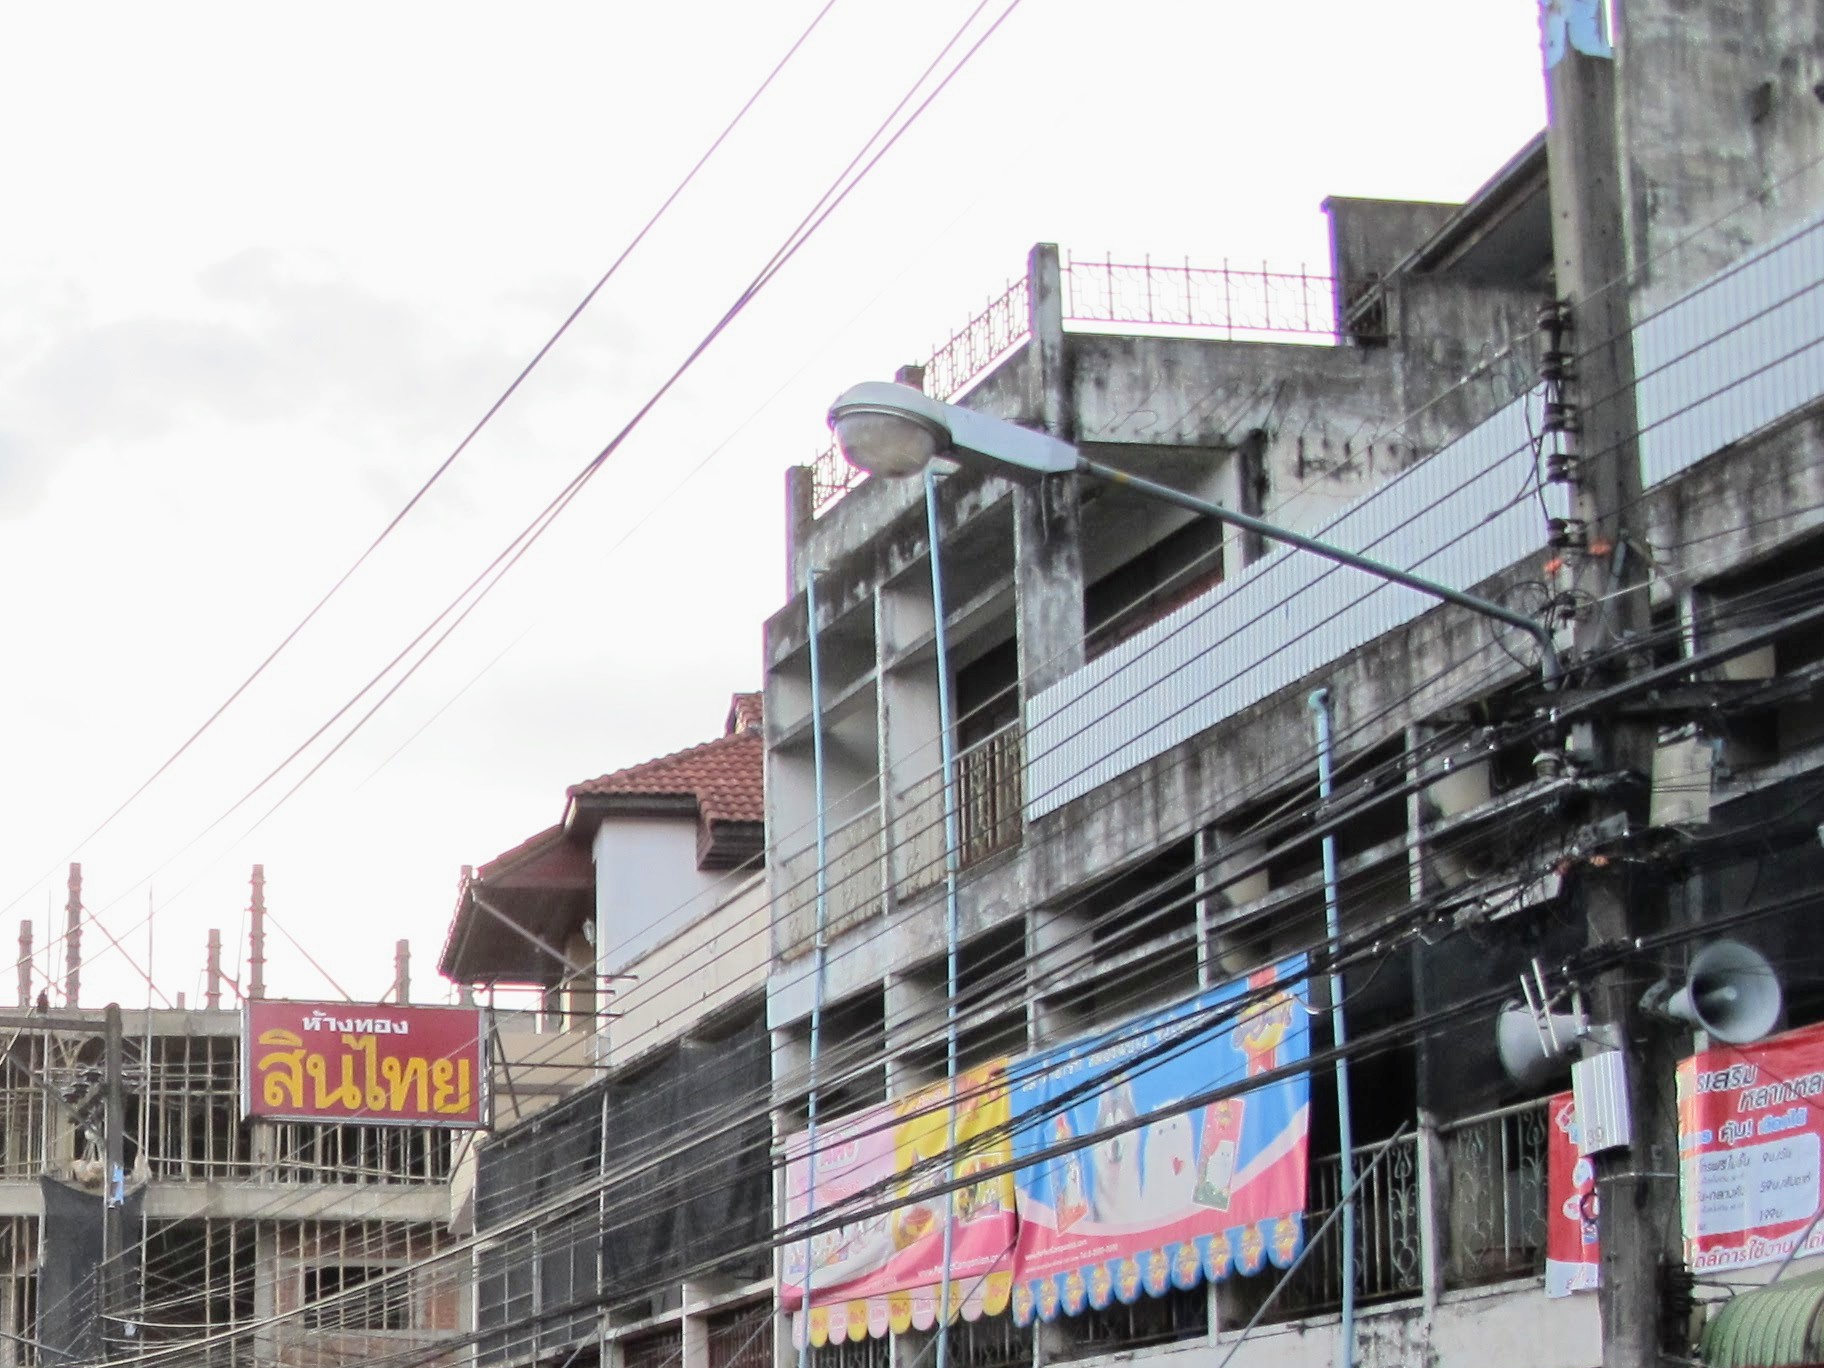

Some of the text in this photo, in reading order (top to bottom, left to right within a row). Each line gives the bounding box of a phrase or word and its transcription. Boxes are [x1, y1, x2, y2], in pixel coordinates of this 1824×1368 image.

[302, 1010, 409, 1034] ห้างทอง
[257, 1028, 470, 1114] สินไทย
